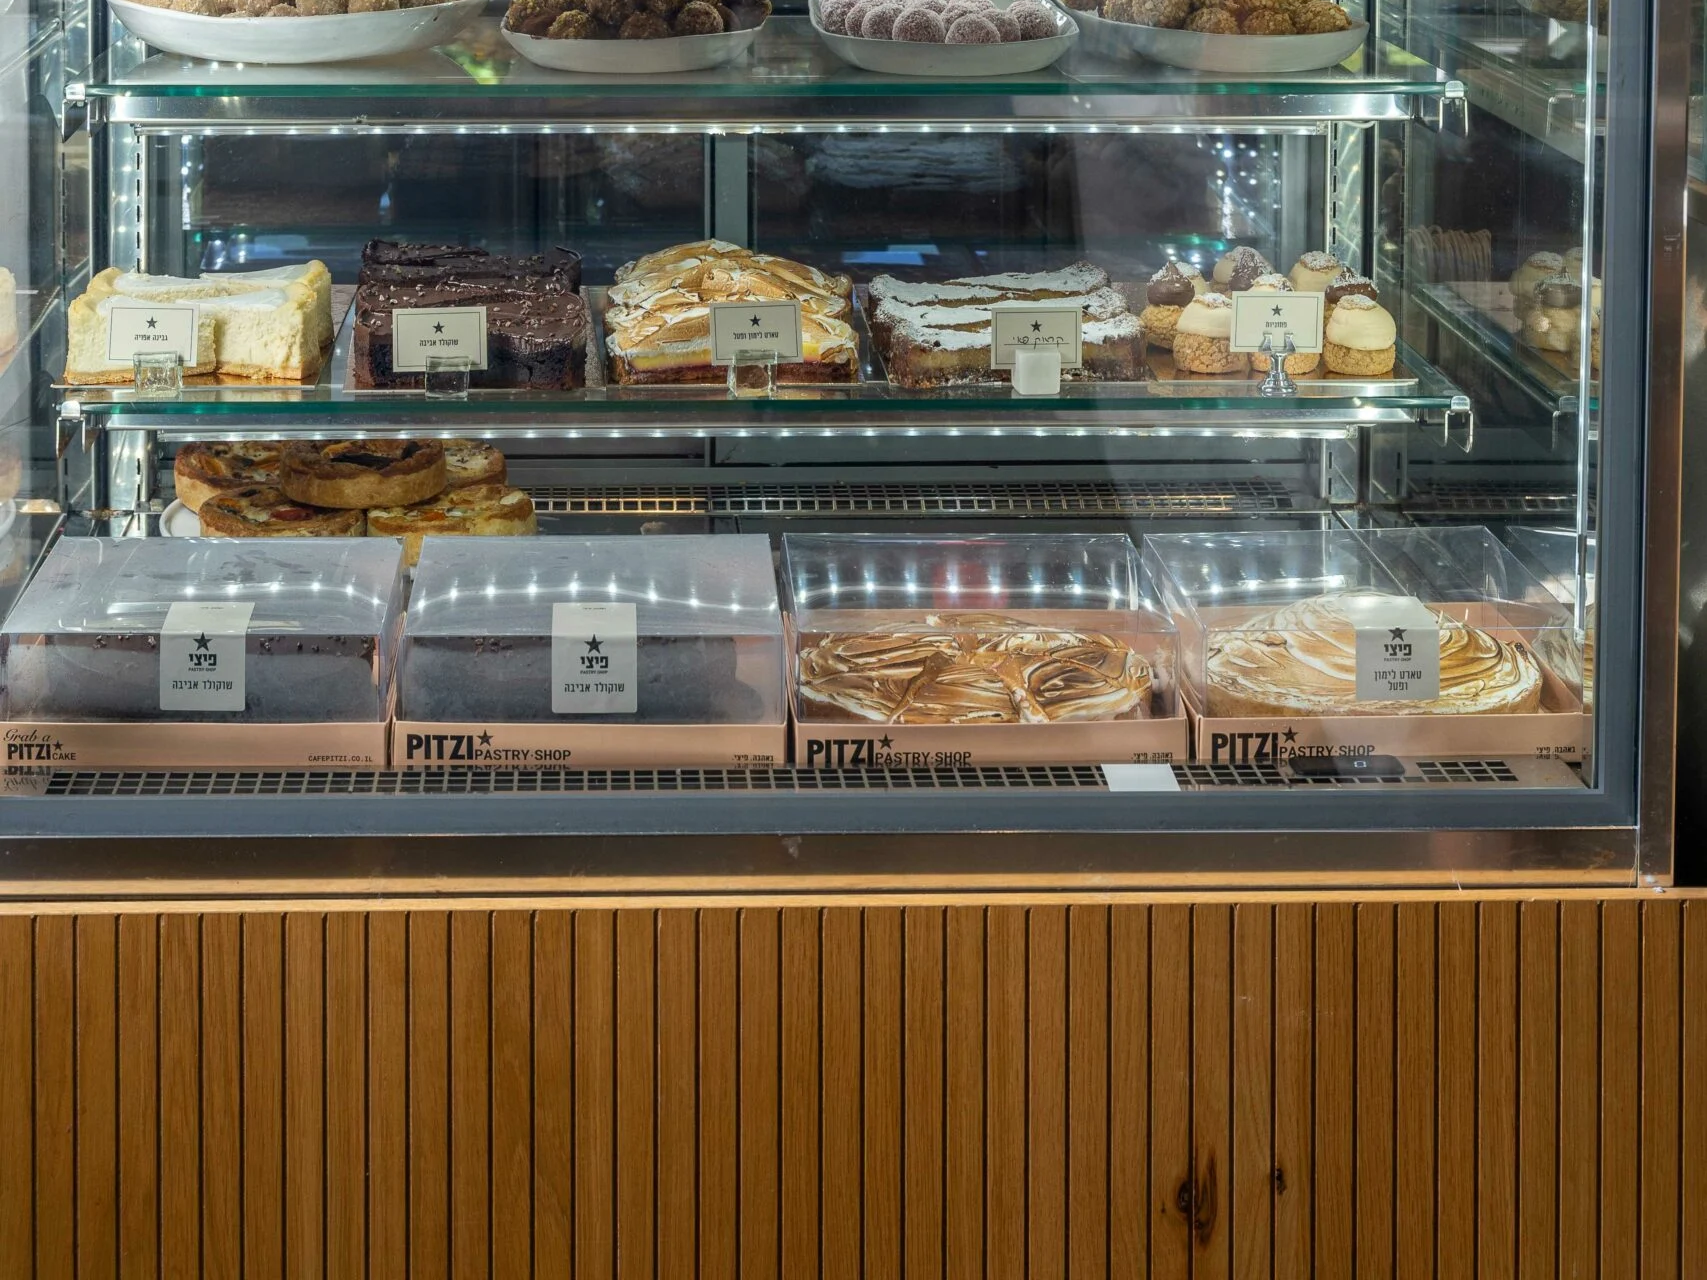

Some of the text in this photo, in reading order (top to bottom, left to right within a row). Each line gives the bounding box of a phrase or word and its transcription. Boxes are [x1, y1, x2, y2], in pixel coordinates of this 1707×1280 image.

[764, 331, 779, 339] טארט
[438, 338, 459, 347] שוקולד
[1383, 643, 1412, 656] פיצי
[188, 653, 217, 667] פיצי
[580, 655, 609, 669] פיצי
[1374, 668, 1422, 682] טארט לימון
[172, 679, 233, 692] שוקולד אביבה
[564, 681, 625, 694] שוקולד אביבה
[1387, 680, 1408, 691] ופטל
[3, 728, 52, 742] Grab a
[7, 743, 77, 760] PITZI CAKE
[406, 734, 474, 760] PITZI
[807, 739, 875, 764] PITZI
[1211, 733, 1279, 759] PITZI
